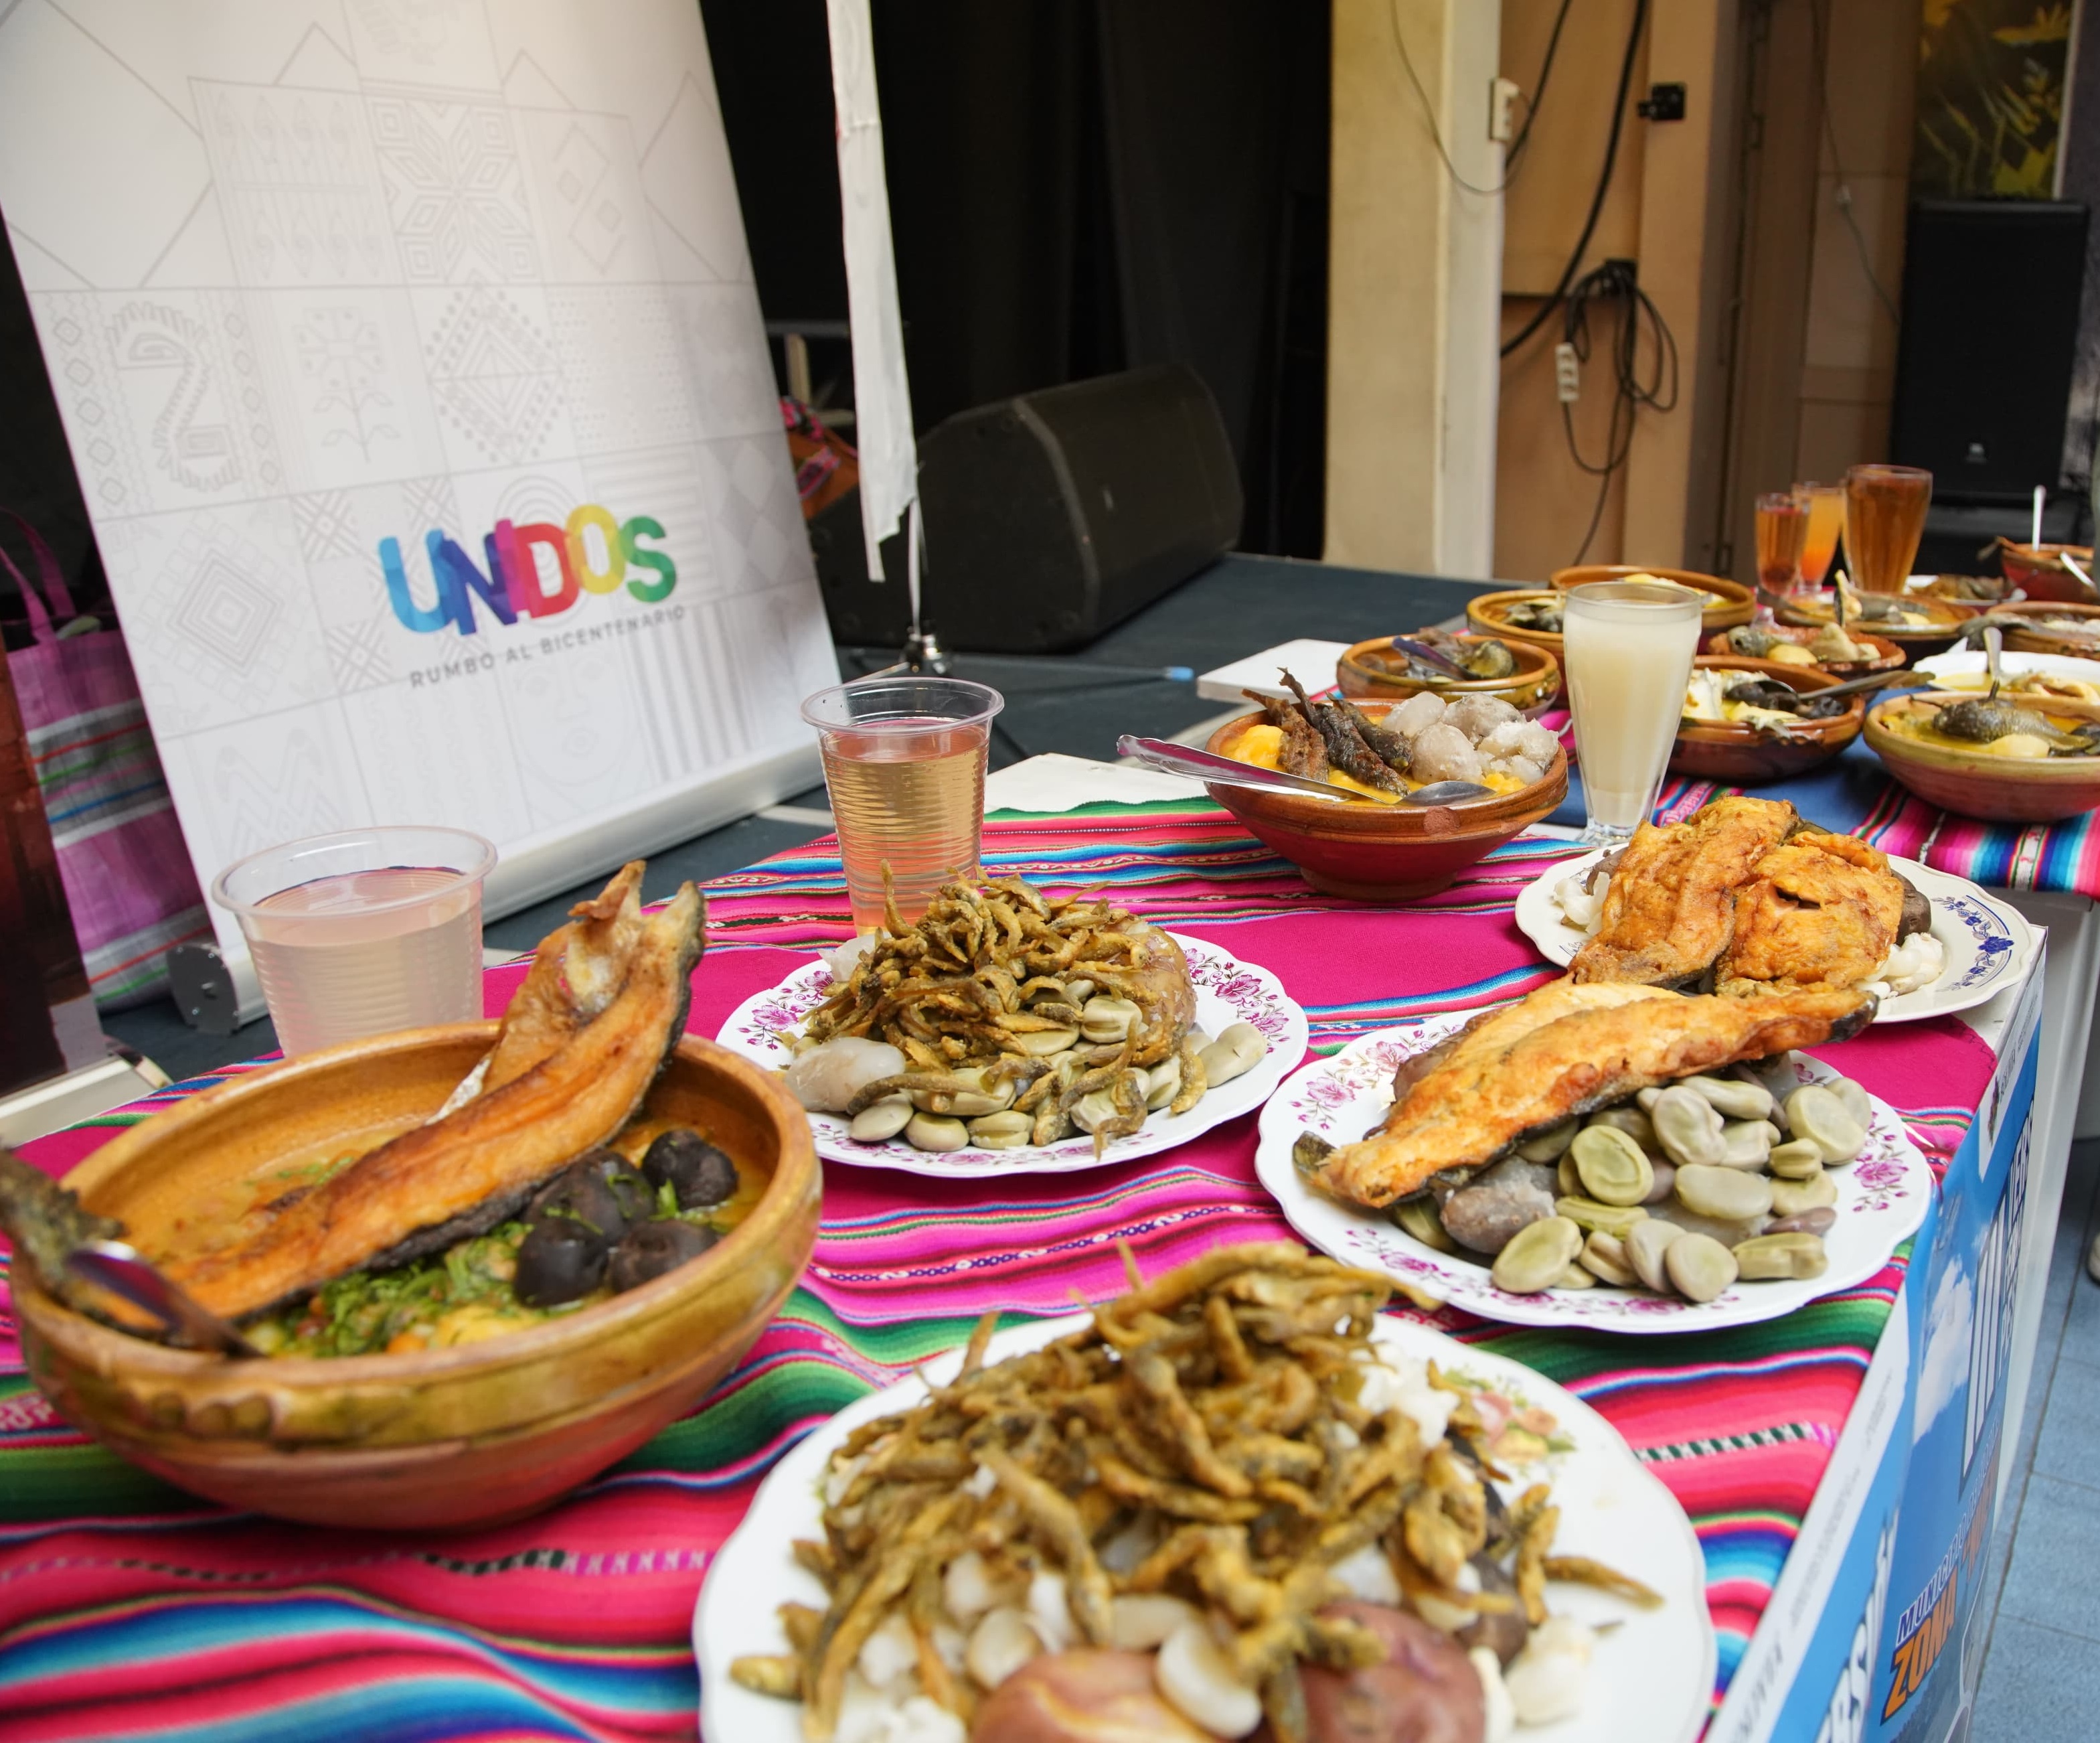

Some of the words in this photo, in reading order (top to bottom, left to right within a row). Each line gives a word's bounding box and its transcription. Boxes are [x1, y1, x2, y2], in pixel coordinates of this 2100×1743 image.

[378, 504, 677, 635] UNIDOS
[410, 653, 495, 688] RUMBO
[506, 641, 533, 664] AL
[541, 605, 685, 655] BICENTENARIO
[1882, 1565, 1959, 1722] ZONA
[1896, 1512, 1967, 1648] MUNICIPIO
